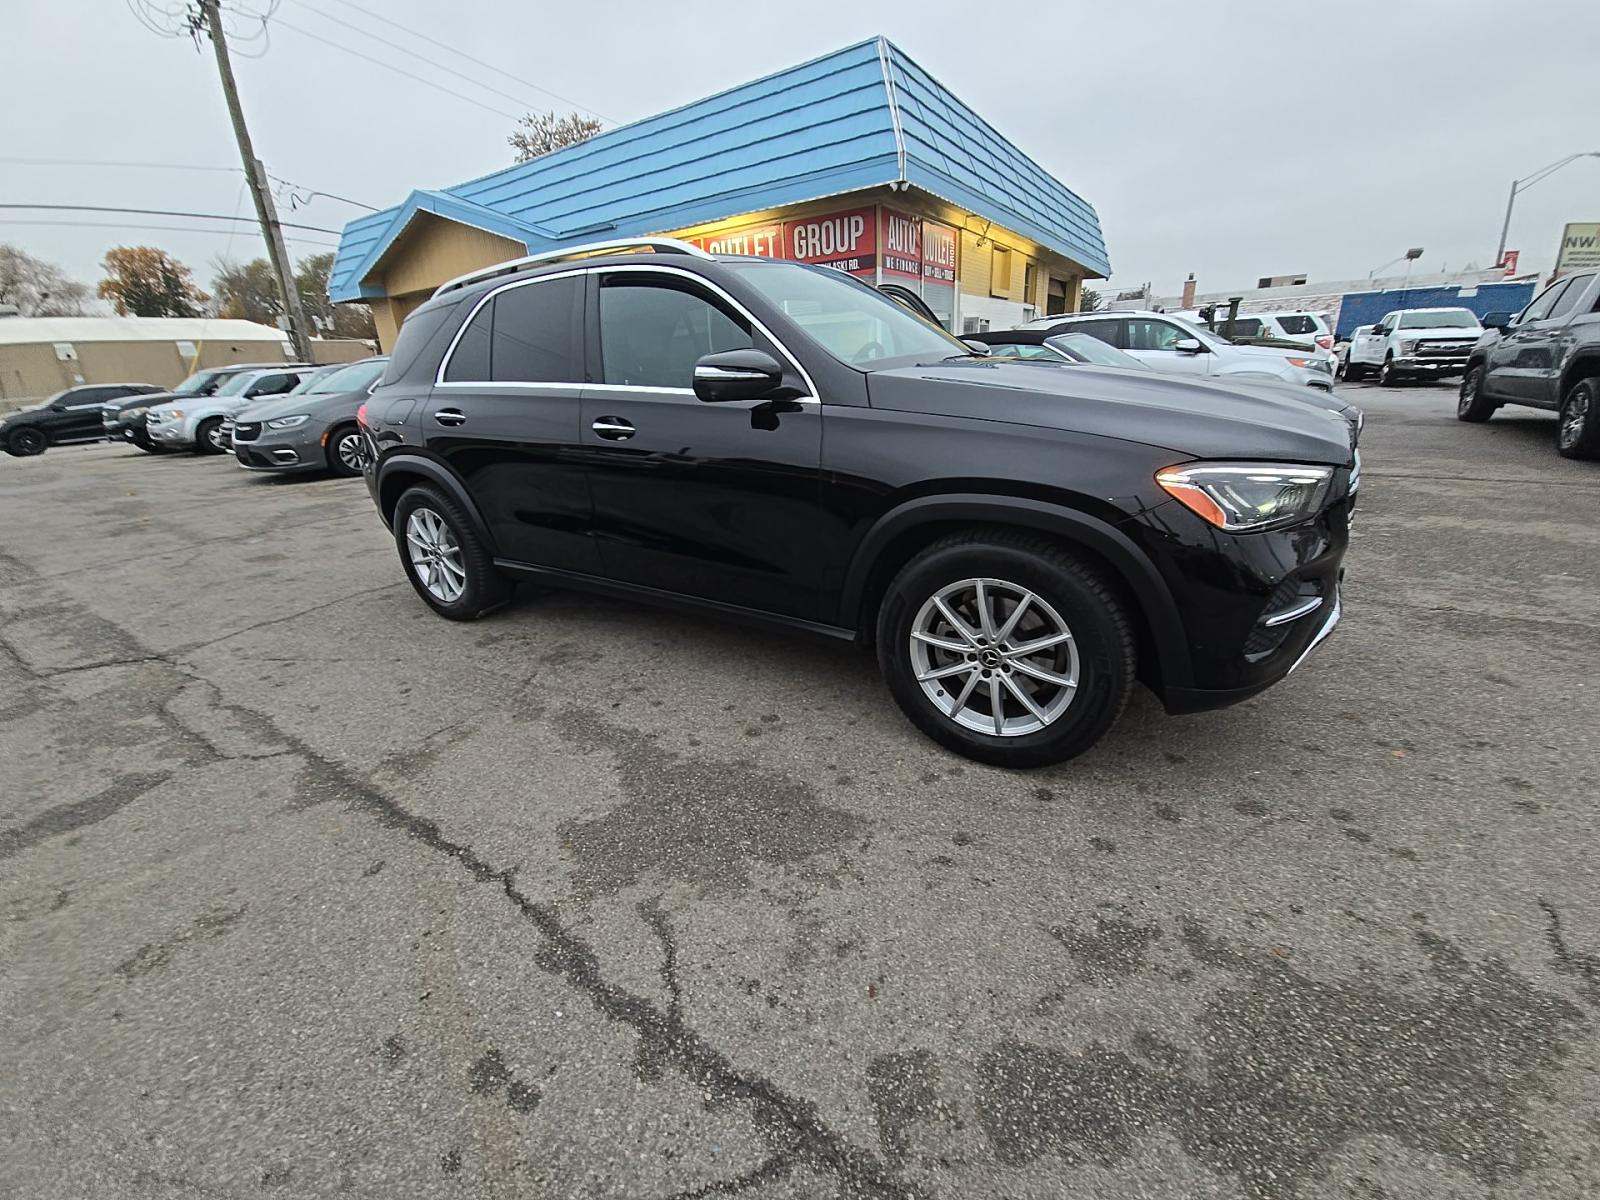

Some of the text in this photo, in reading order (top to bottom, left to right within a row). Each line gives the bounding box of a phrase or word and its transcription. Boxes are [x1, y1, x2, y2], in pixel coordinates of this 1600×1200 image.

[709, 214, 865, 259] OUTLET GROUP
[888, 216, 916, 256] AUTO
